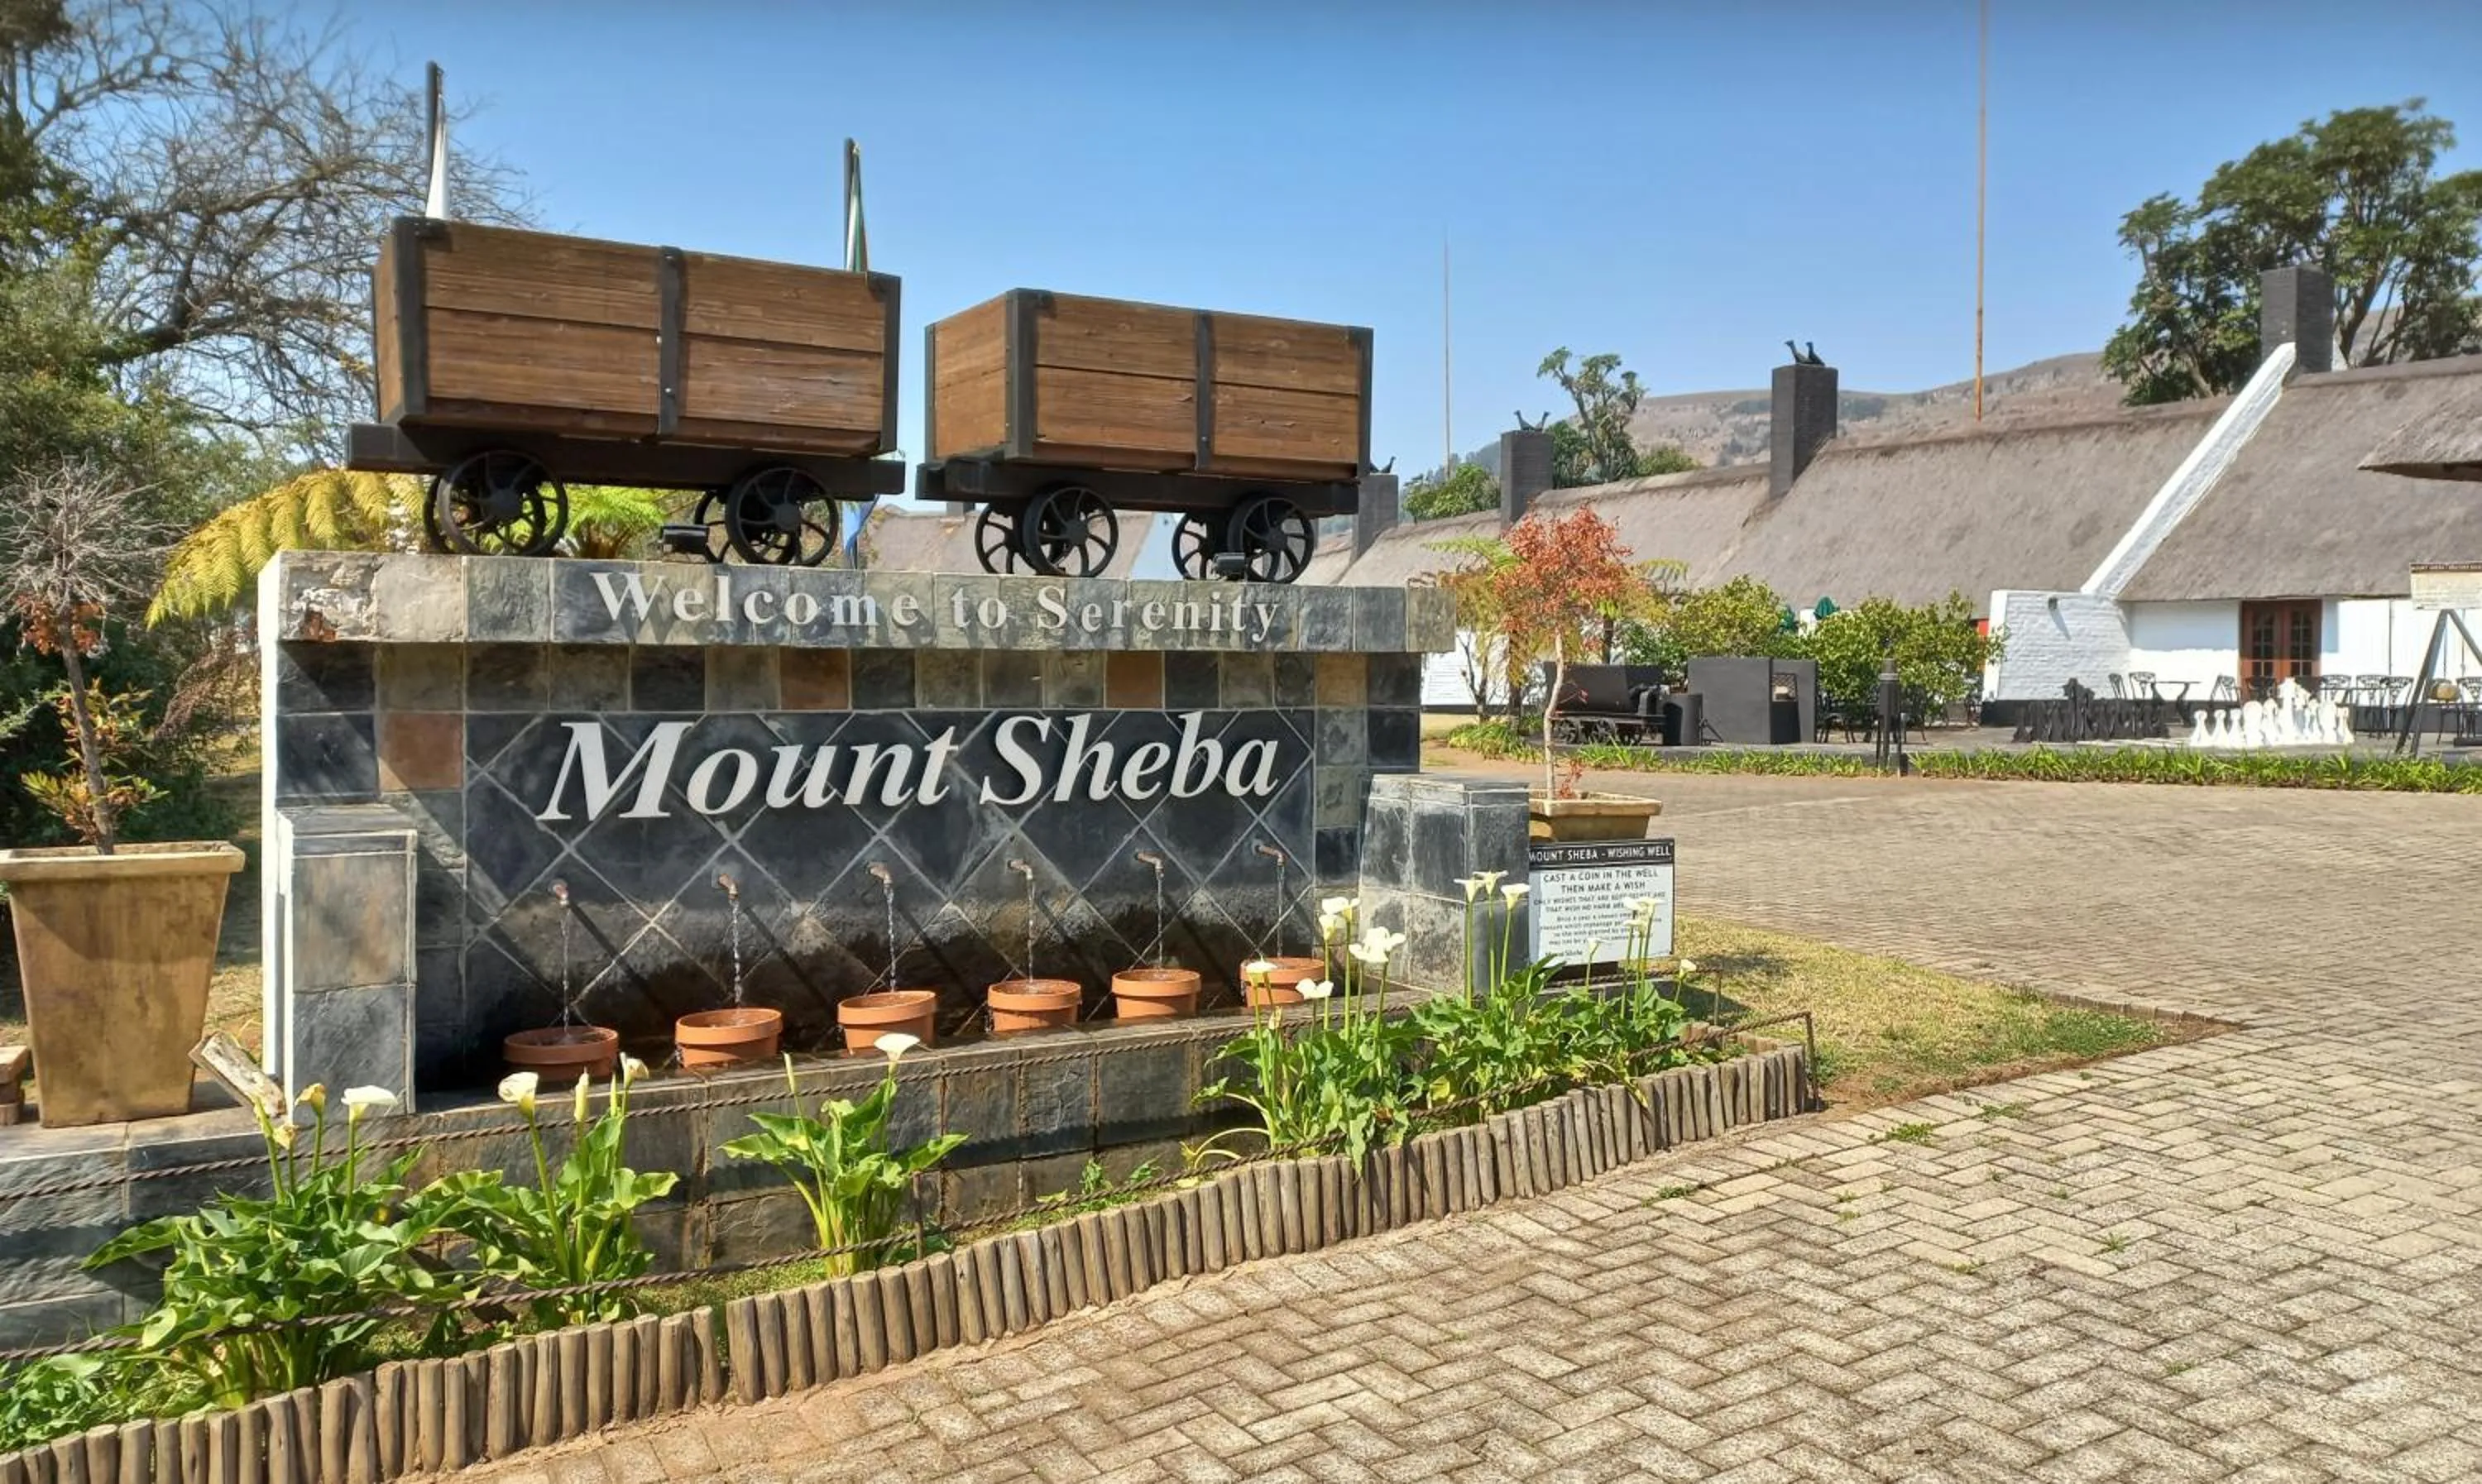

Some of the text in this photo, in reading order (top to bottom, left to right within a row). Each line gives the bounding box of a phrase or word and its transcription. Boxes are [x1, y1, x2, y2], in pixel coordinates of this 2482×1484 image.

[589, 571, 1279, 642] Welcome to Serenity
[535, 711, 1280, 821] Mount Sheba
[1529, 850, 1563, 862] MOUNT
[1568, 849, 1598, 860] SHEBA
[1608, 846, 1645, 859] WISHING
[1647, 845, 1671, 857] WELL
[1543, 868, 1659, 883] CAST A COIN IN THE WELL
[1560, 881, 1646, 893] THEN MAKE A WISH
